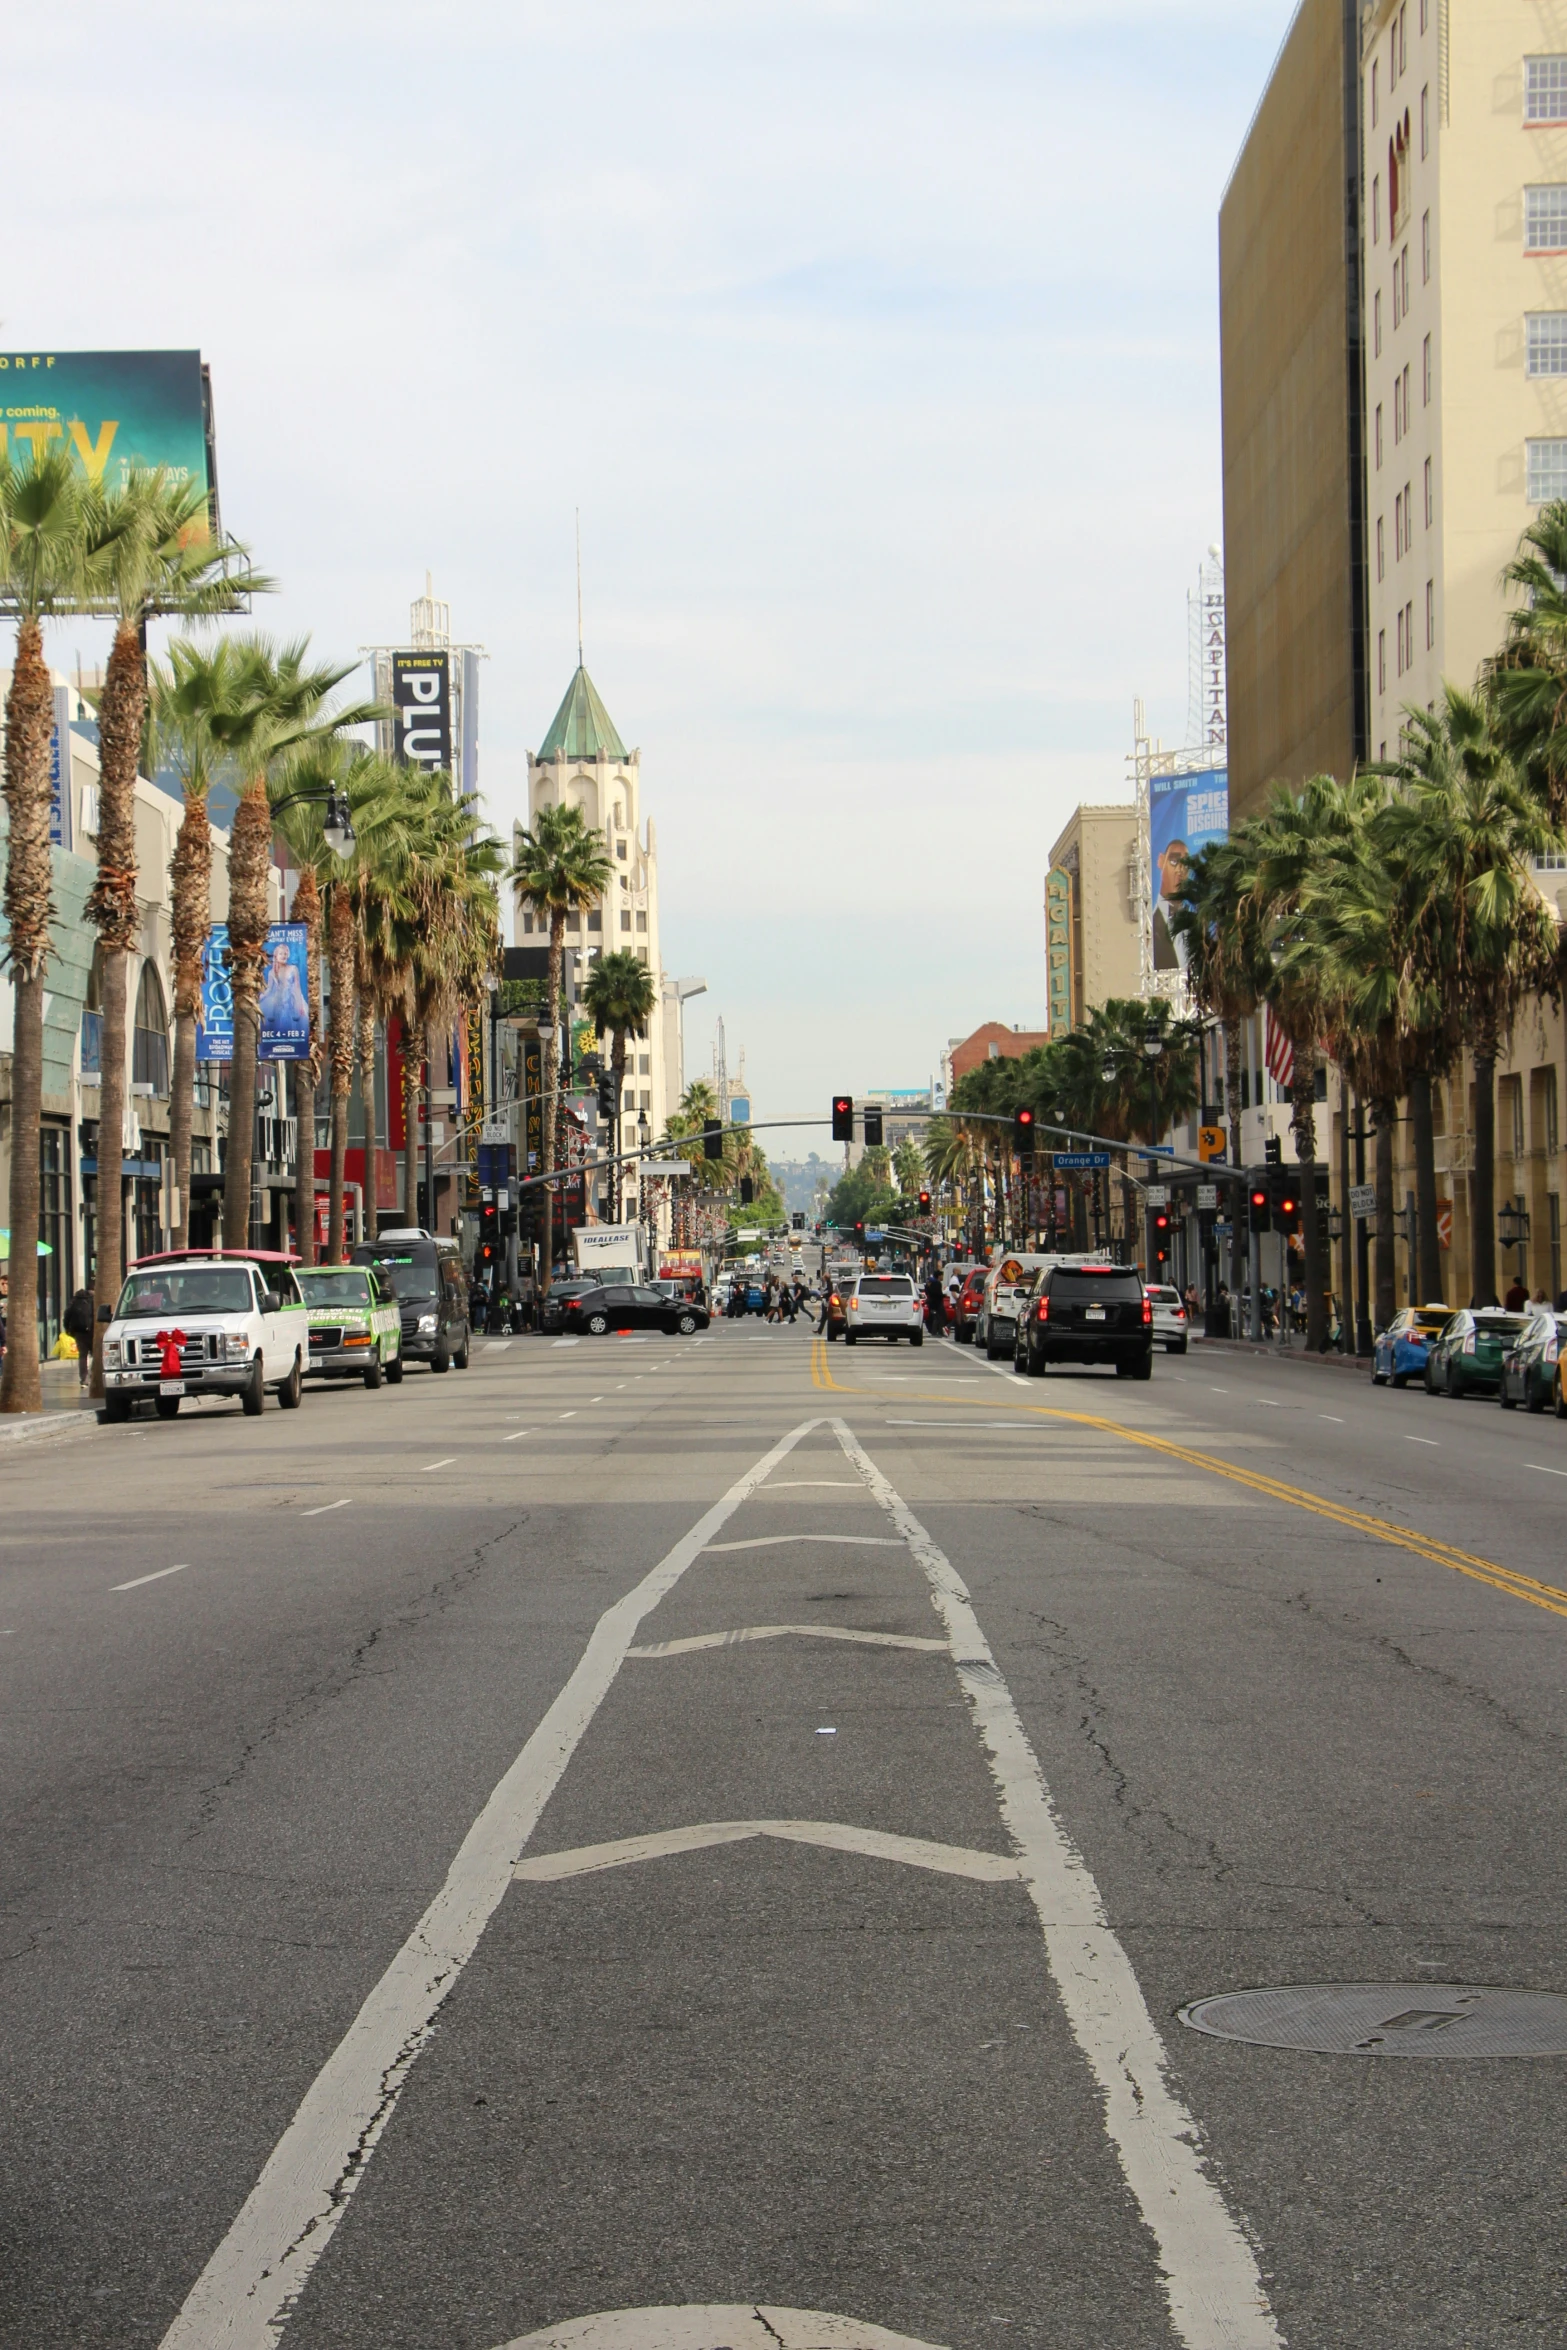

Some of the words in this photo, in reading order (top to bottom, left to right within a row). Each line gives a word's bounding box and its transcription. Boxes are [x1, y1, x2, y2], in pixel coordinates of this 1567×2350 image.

[6, 405, 60, 419] coming.
[398, 659, 412, 668] IT'S
[413, 659, 432, 667] FREE
[1206, 611, 1226, 744] CAPITAN
[402, 673, 442, 771] PLU
[1173, 777, 1198, 790] SMITH
[1187, 791, 1228, 812] SPIES
[1048, 882, 1068, 900] EL
[1058, 1156, 1090, 1166] Orange
[1094, 1156, 1105, 1164] Dr
[1361, 1188, 1372, 1196] NOT
[1352, 1200, 1374, 1208] BLOCK
[583, 1234, 630, 1244] IDEALEASE
